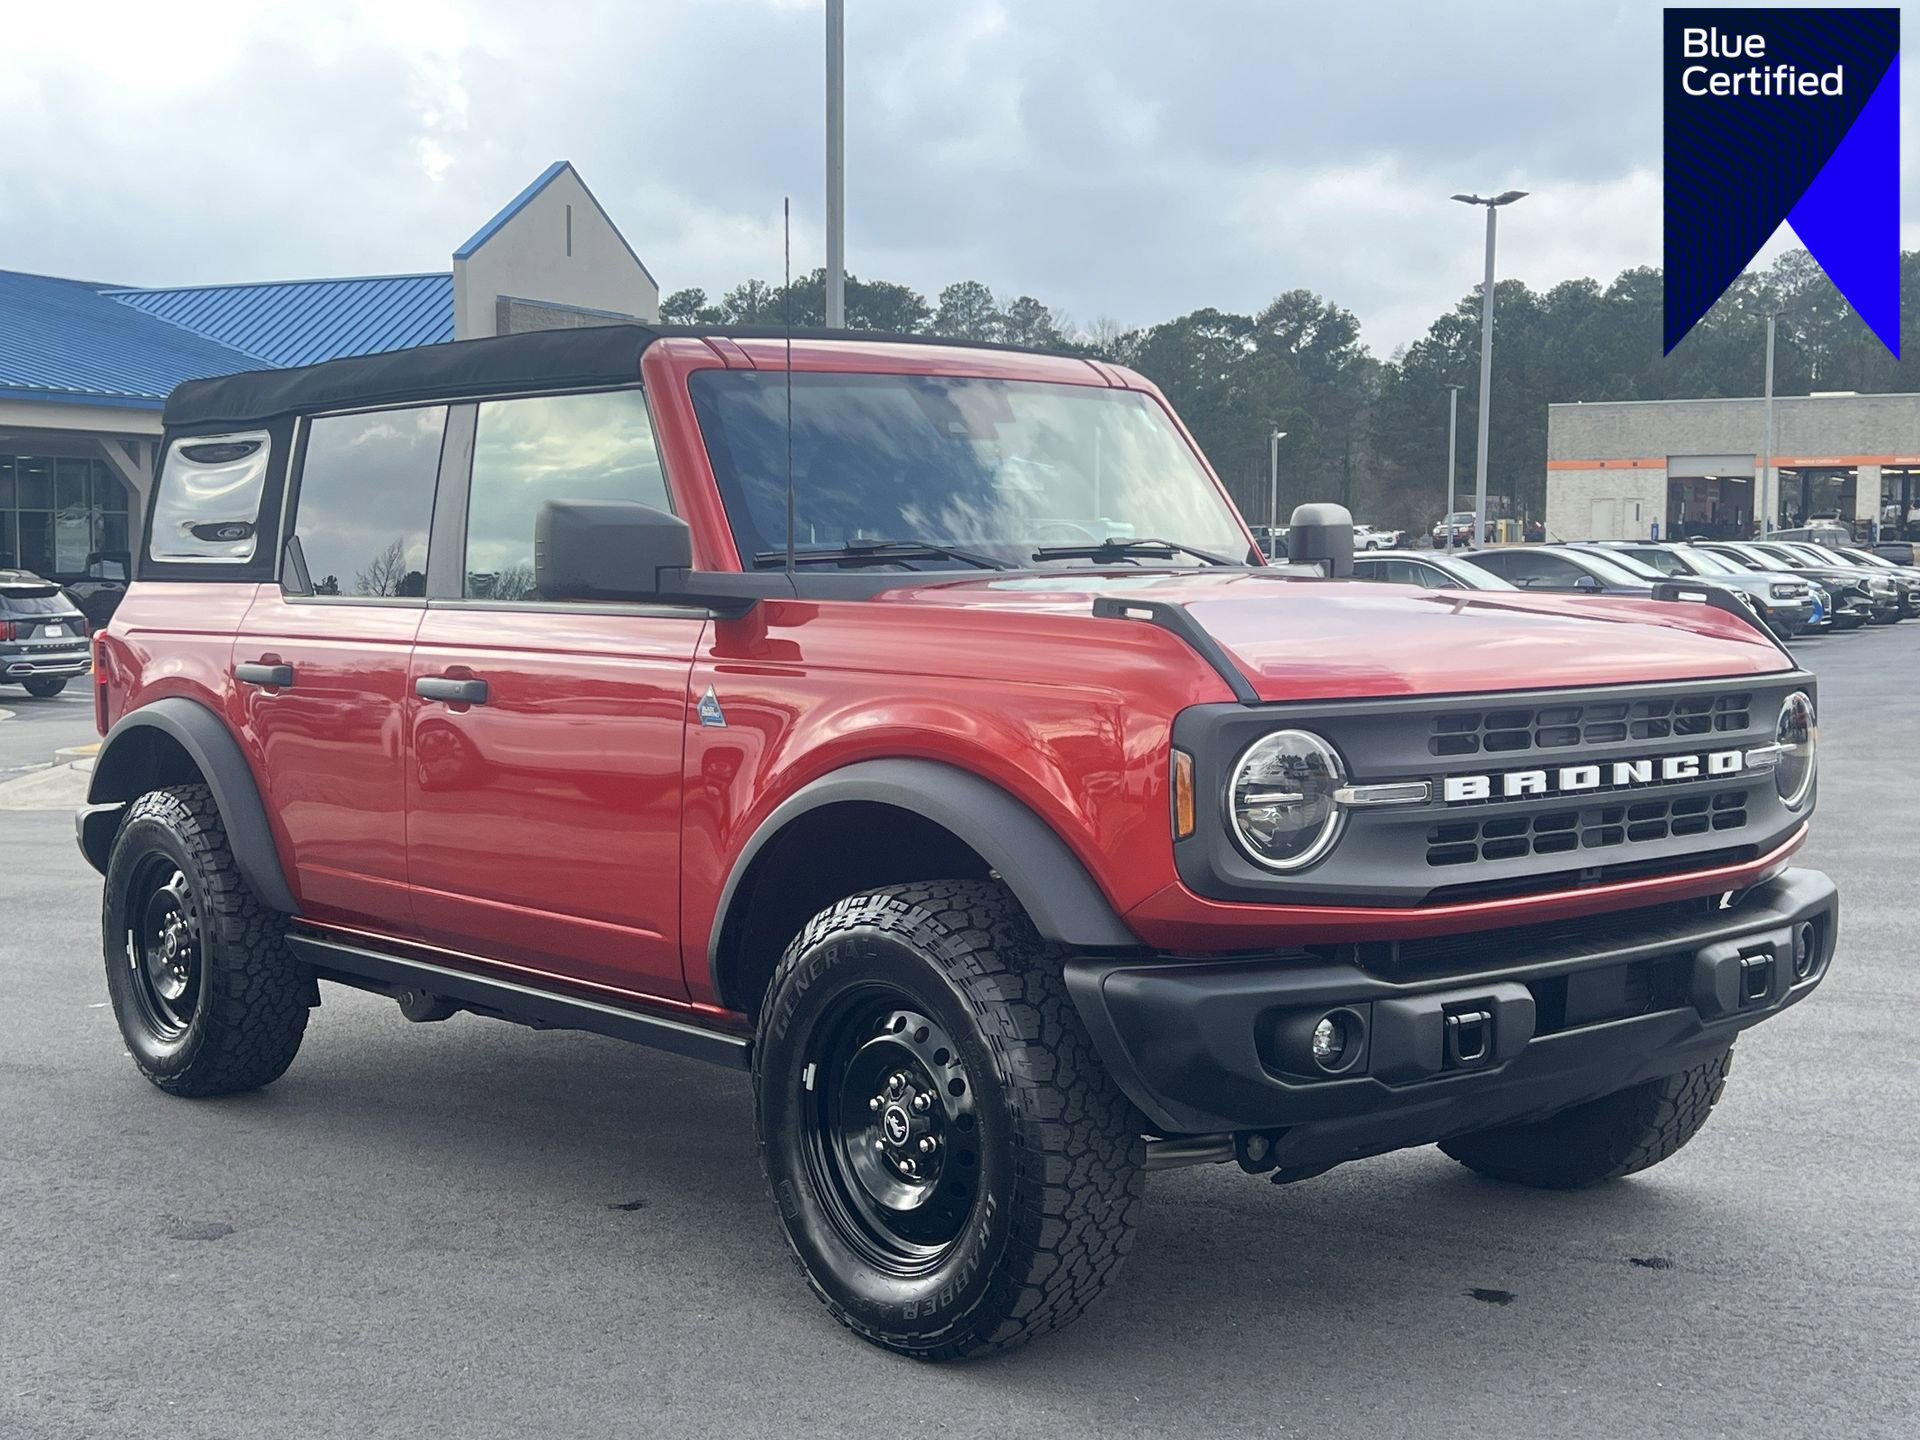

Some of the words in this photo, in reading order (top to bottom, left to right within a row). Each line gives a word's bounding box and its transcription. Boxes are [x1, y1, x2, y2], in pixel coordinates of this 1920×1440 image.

[1444, 750, 1743, 801] BRONCO
[775, 938, 878, 1041] GENERAL
[903, 1190, 997, 1320] GRABBER
